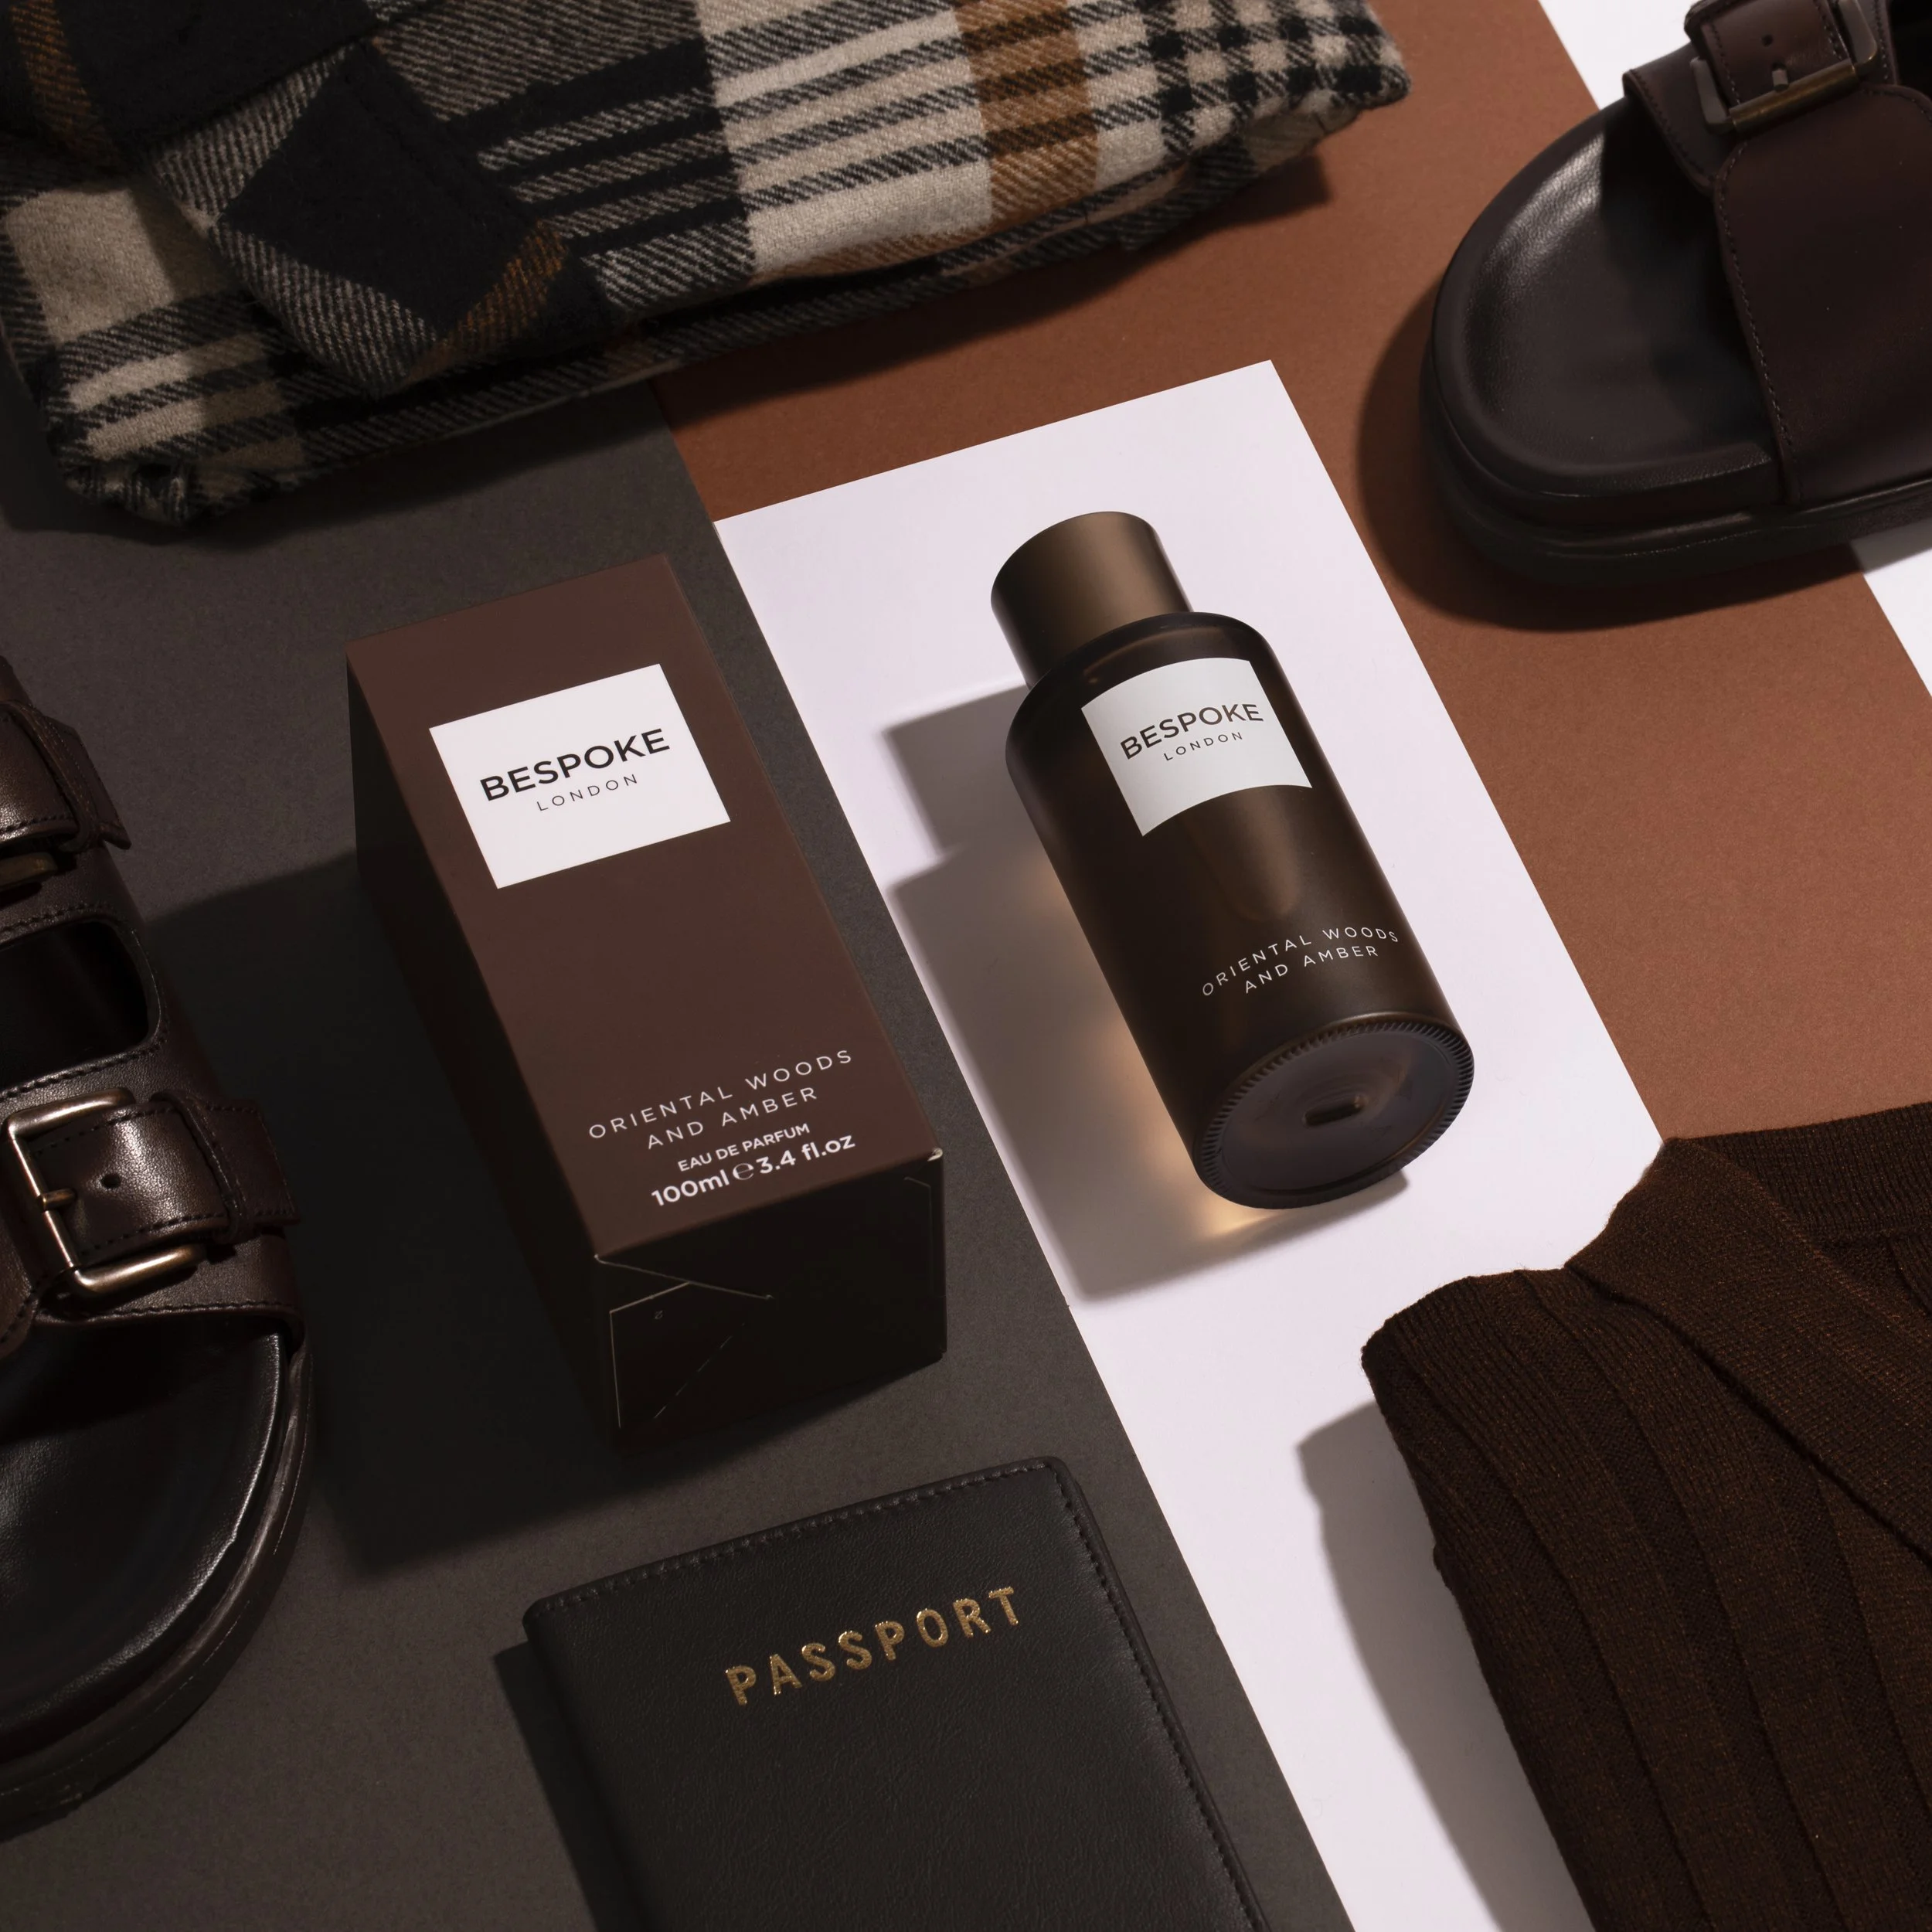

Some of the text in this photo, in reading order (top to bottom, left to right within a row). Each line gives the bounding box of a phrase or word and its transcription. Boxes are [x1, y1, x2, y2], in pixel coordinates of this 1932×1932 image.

[1121, 704, 1264, 760] BESPOKE
[1164, 732, 1243, 760] LONDON
[480, 728, 670, 801] BESPOKE
[536, 774, 638, 811] LONDON
[1202, 927, 1398, 995] ORIENTAL WOODS
[1245, 945, 1379, 993] AND AMBER
[589, 1050, 852, 1138] ORIENTAL WOODS
[648, 1087, 818, 1149] AND AMBER
[678, 1124, 810, 1172] EAU DE PARFUM
[651, 1169, 730, 1206] 100ml
[756, 1150, 796, 1174] 3.4
[725, 1587, 1019, 1706] PASSPORT
